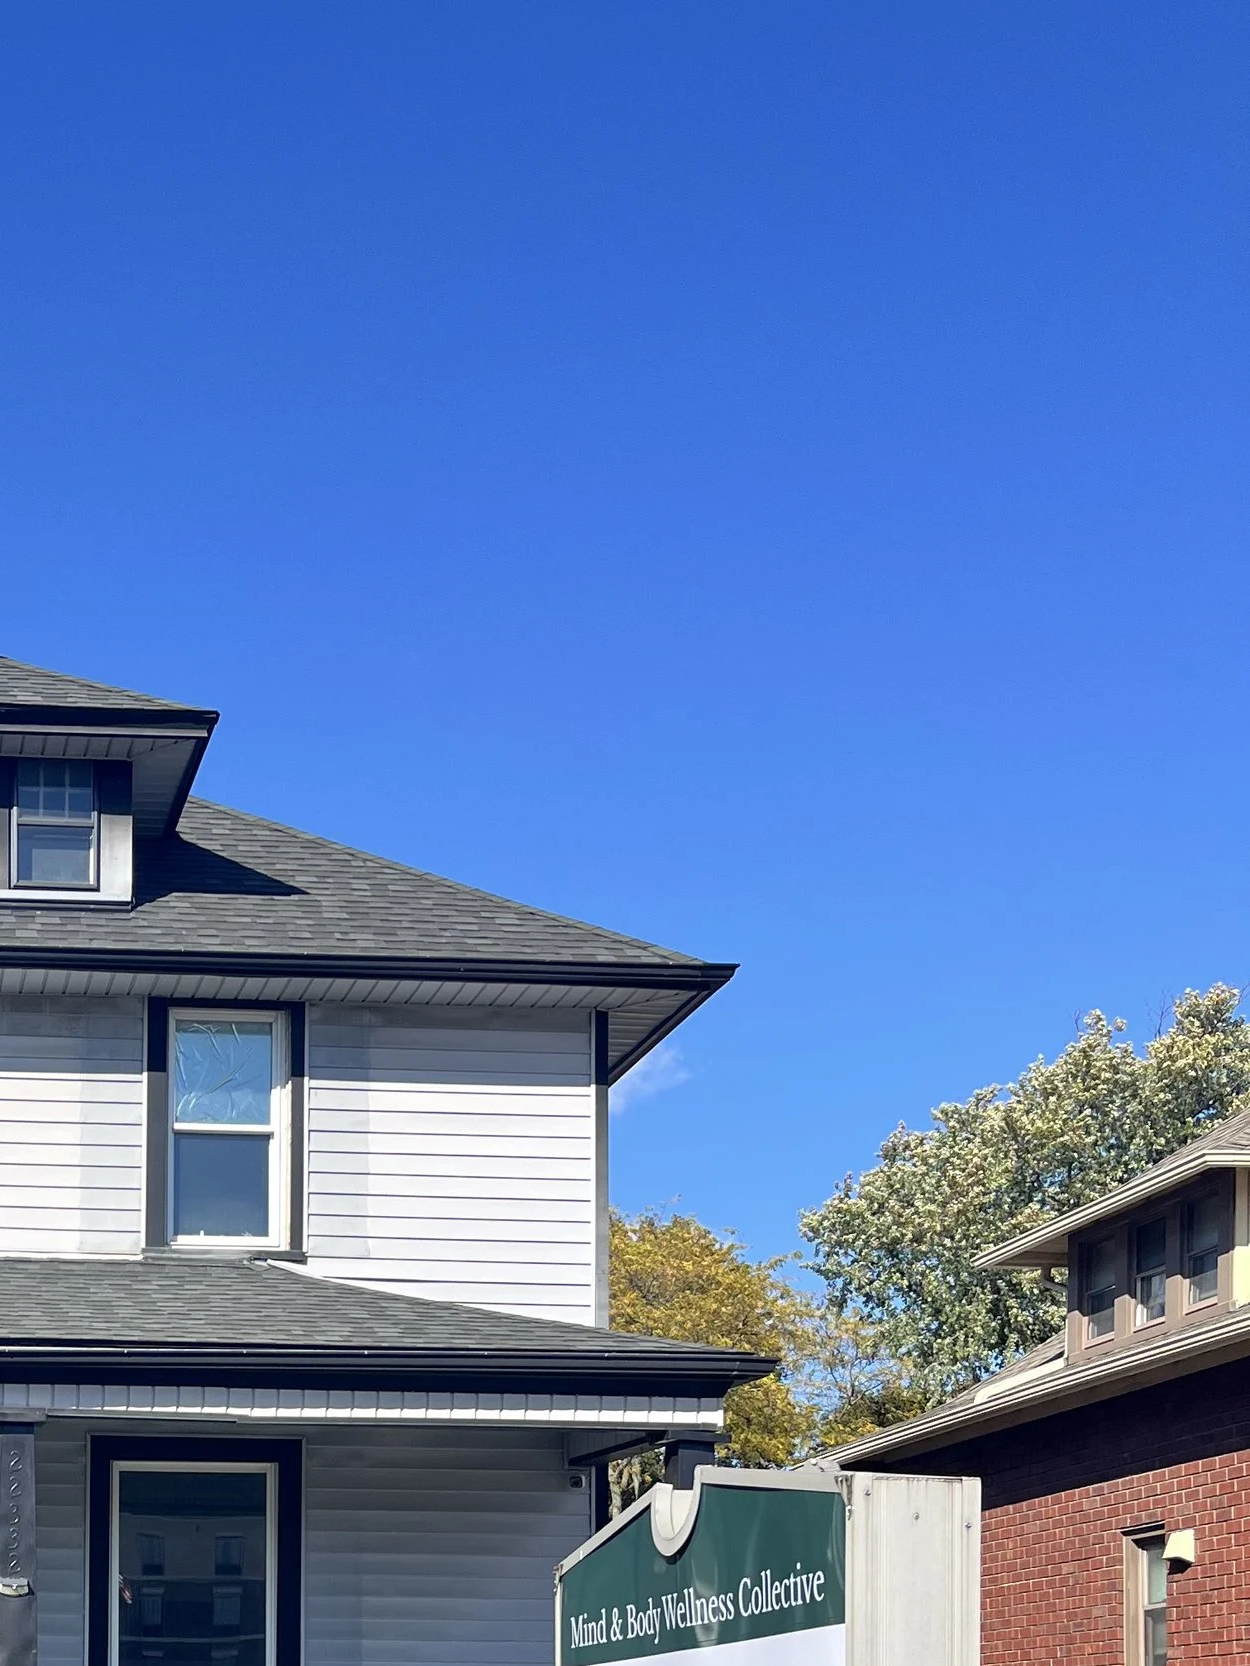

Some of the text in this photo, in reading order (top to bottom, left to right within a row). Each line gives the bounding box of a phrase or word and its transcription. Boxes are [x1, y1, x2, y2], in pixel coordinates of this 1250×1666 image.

[570, 1561, 825, 1649] Mind & Body Wellness Collective
